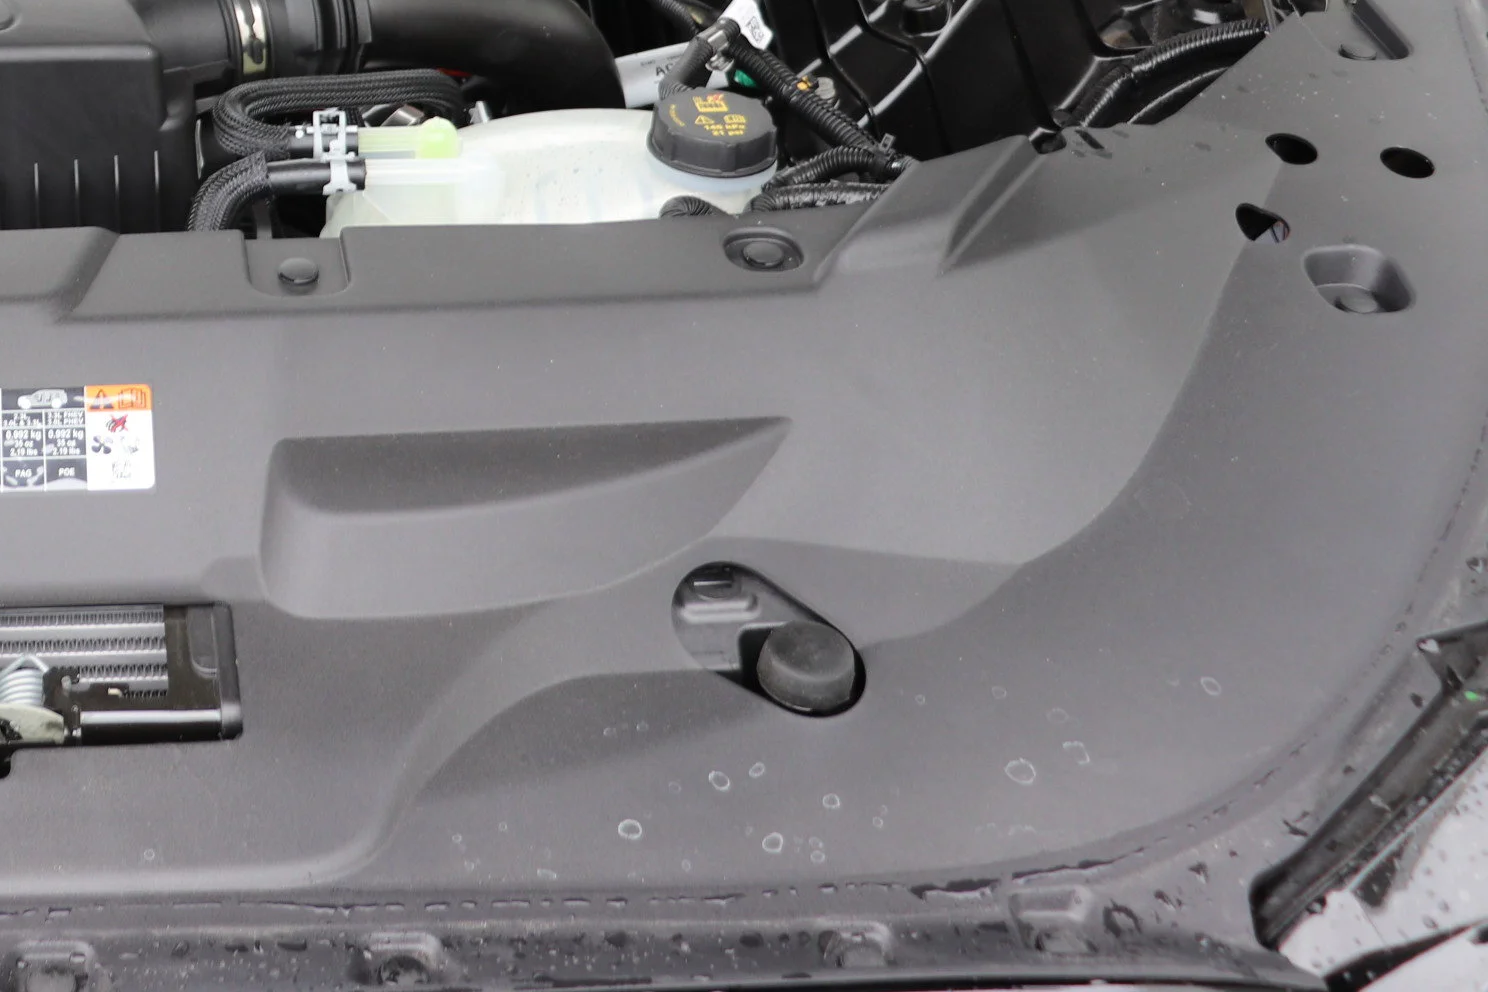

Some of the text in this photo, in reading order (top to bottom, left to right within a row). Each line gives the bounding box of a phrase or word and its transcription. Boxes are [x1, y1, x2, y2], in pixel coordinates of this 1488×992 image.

[30, 429, 42, 441] kg
[72, 428, 84, 440] kg
[15, 468, 32, 478] PAG
[58, 466, 75, 476] POE
